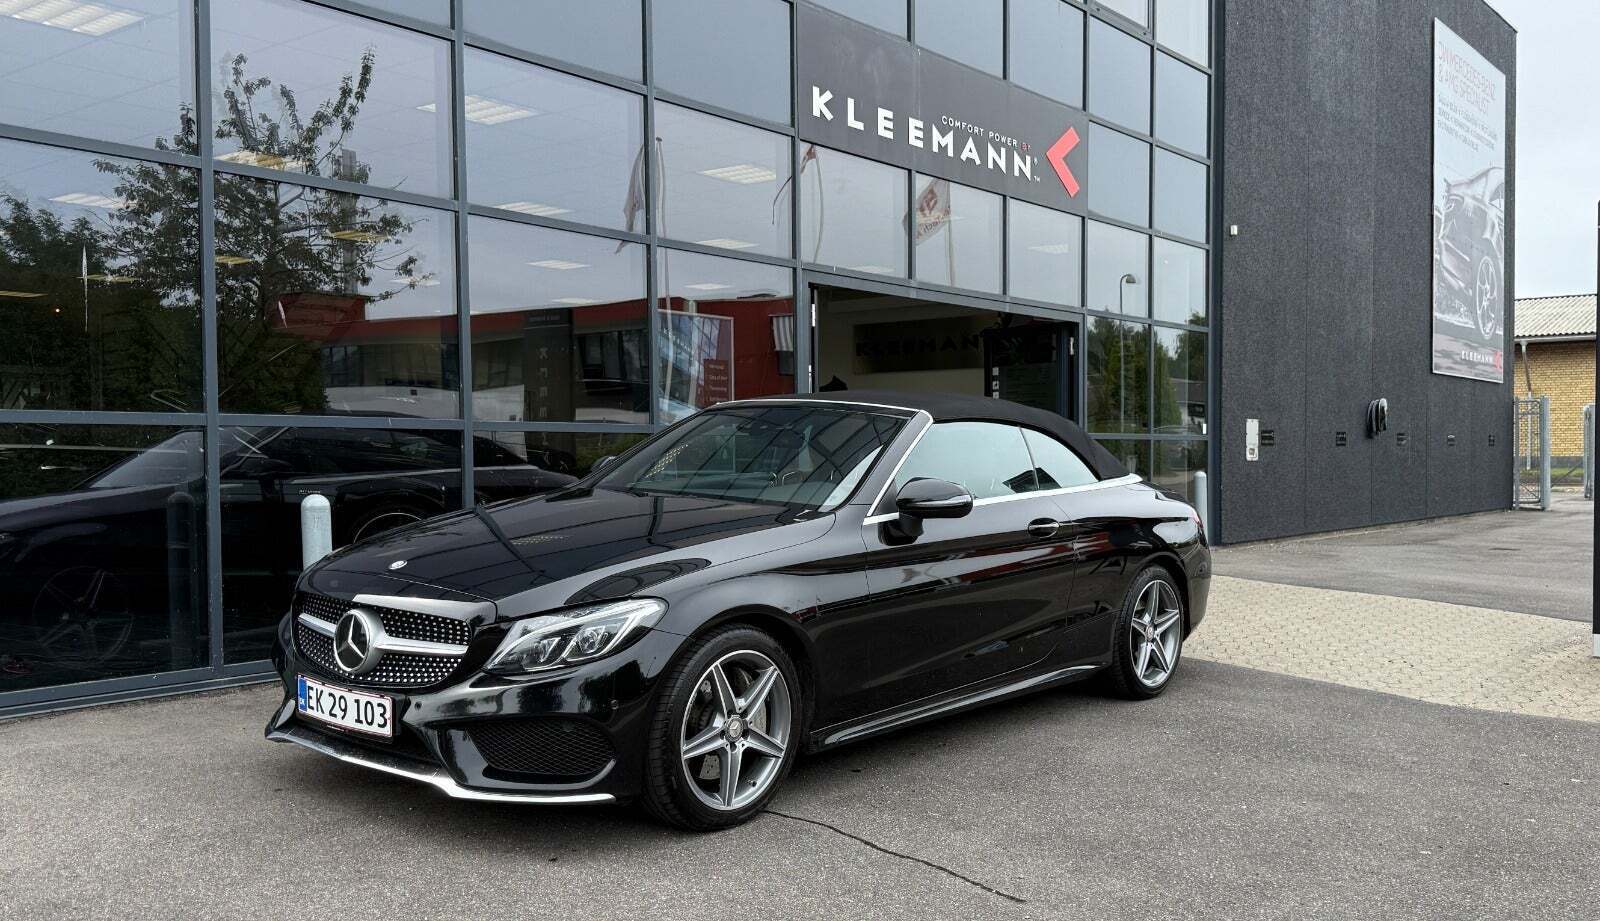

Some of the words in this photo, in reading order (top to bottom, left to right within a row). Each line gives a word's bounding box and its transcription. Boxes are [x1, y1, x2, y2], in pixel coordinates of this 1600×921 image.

[812, 85, 1032, 182] KLEEMANN
[941, 115, 984, 137] COMFORT
[988, 131, 1018, 148] POWER
[307, 685, 325, 714] EK
[328, 692, 348, 720] 29
[354, 698, 388, 729] 103
